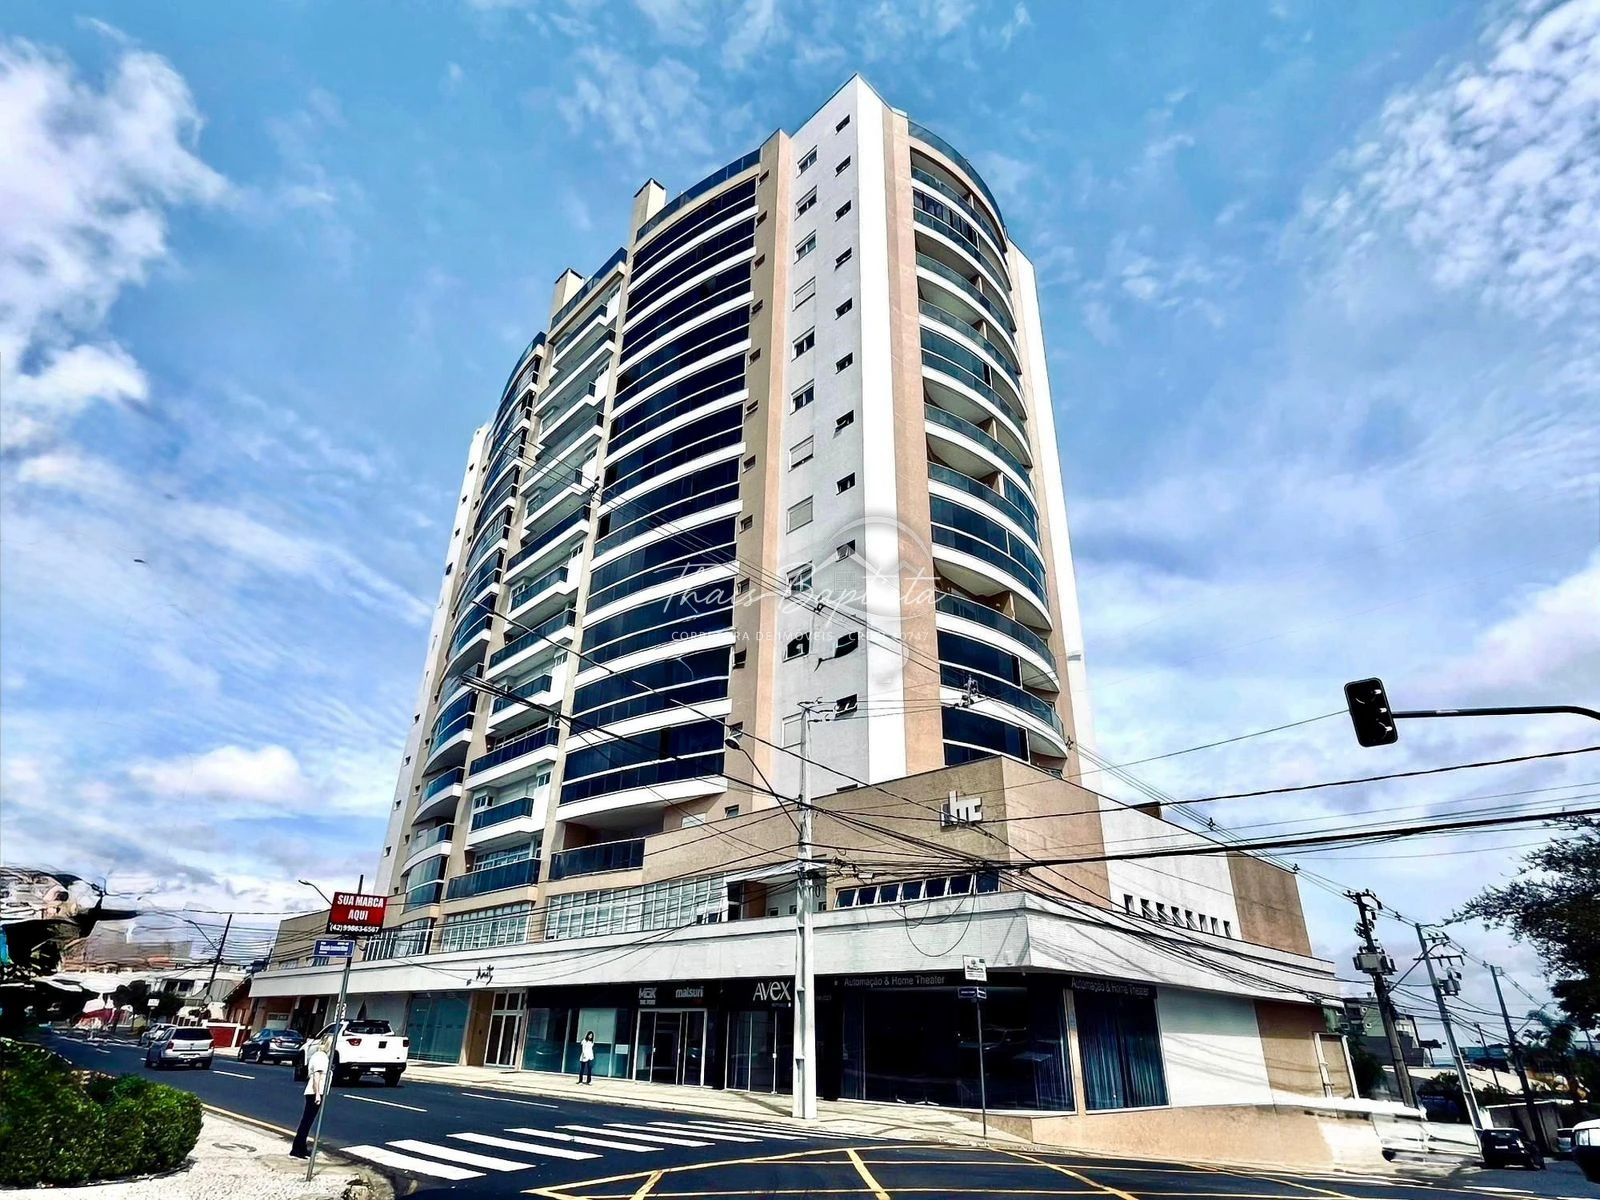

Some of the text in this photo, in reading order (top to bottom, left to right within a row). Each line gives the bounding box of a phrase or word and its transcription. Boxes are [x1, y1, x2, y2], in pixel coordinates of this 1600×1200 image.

[337, 895, 384, 908] SUA MARCA
[348, 909, 368, 920] AQUI
